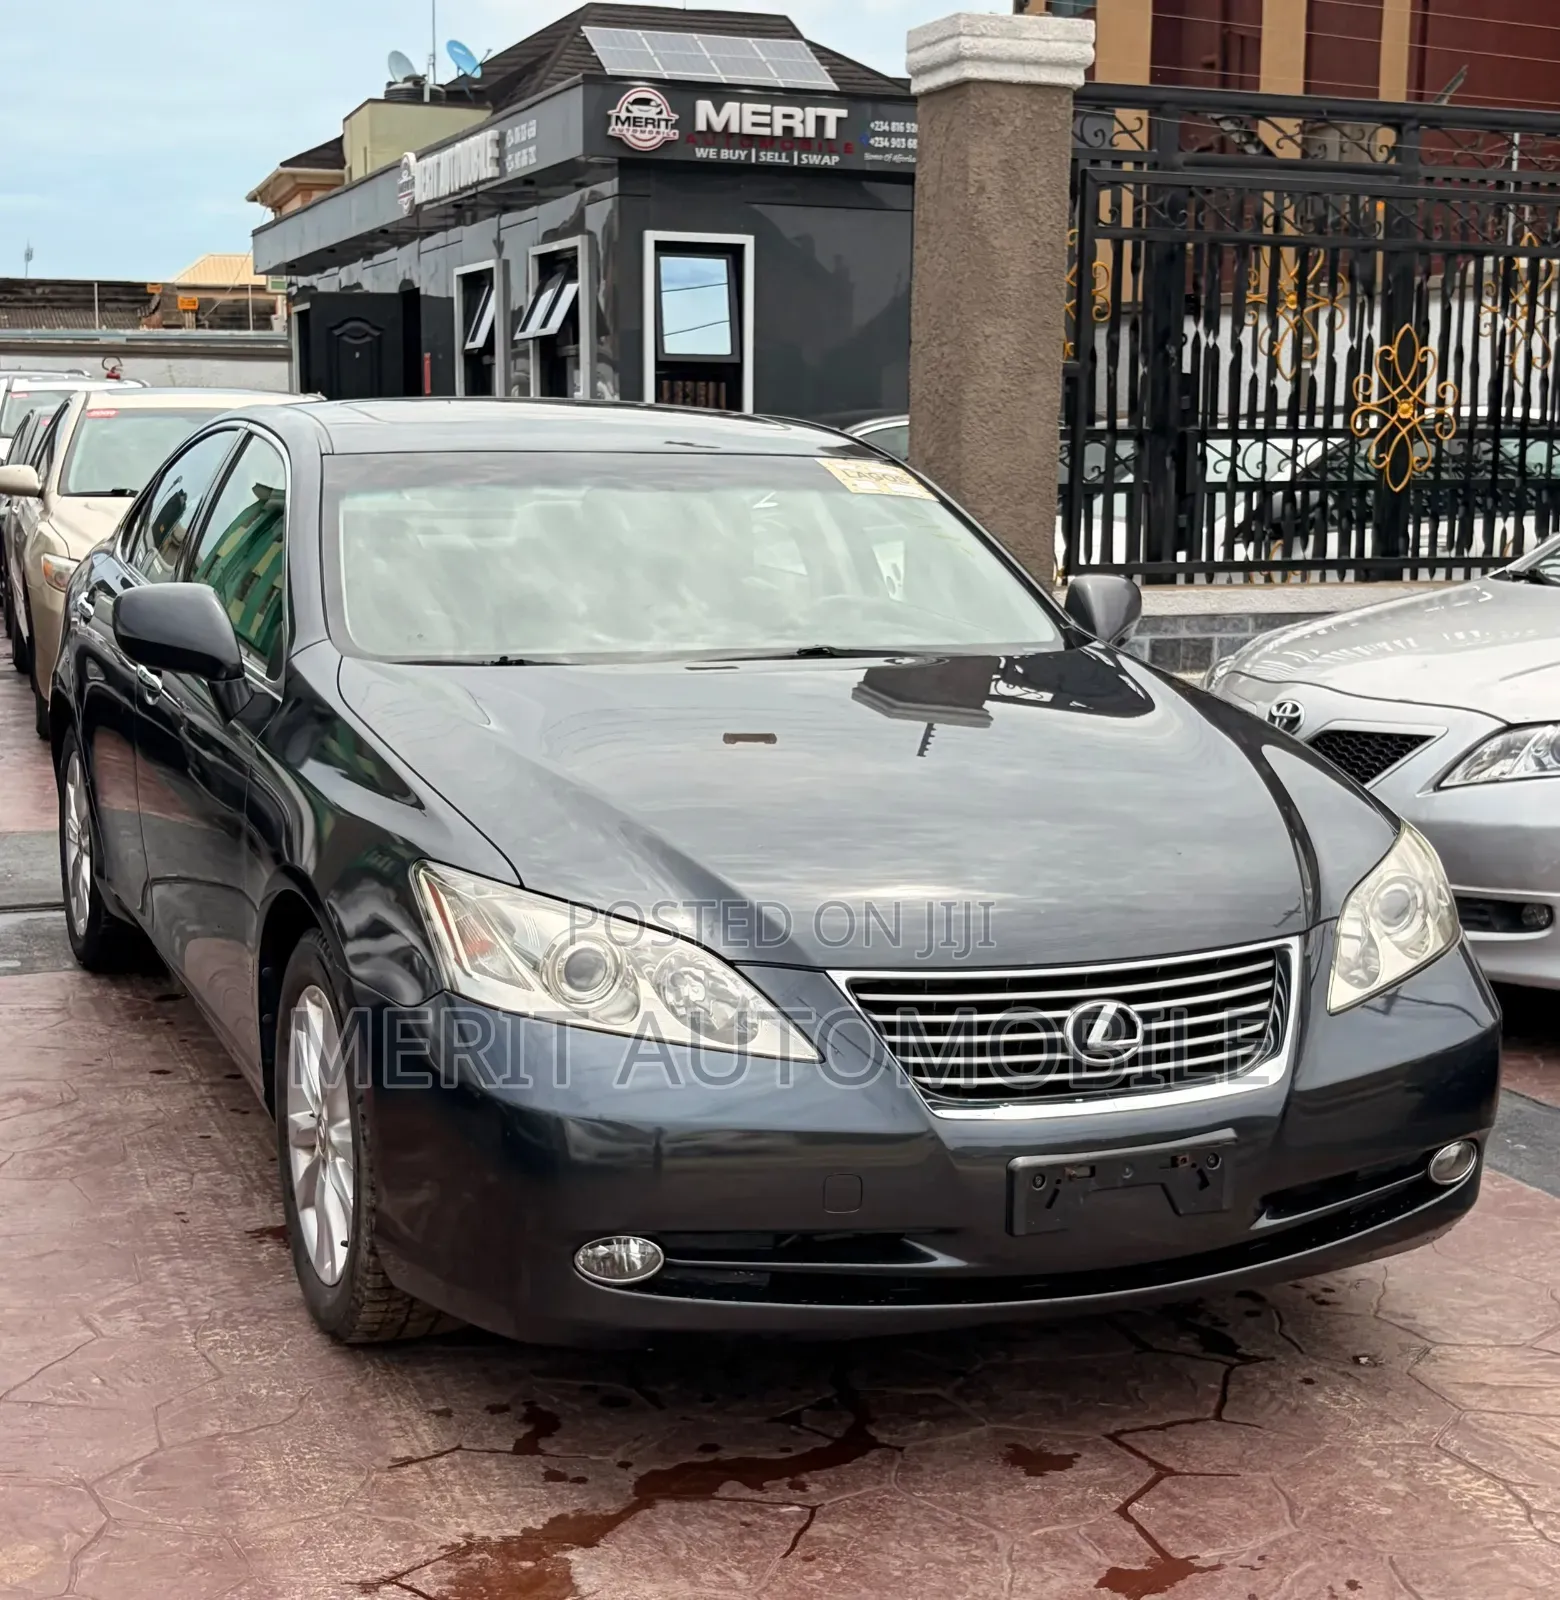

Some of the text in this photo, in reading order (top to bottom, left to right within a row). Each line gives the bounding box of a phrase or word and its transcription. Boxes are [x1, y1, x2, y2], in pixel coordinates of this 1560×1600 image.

[614, 115, 673, 130] MERIT
[694, 99, 848, 139] MERIT
[611, 127, 678, 137] AUTOMOBILE
[685, 132, 855, 155] AUTOMOBILE
[695, 147, 841, 166] WE BUY SELL SWAP
